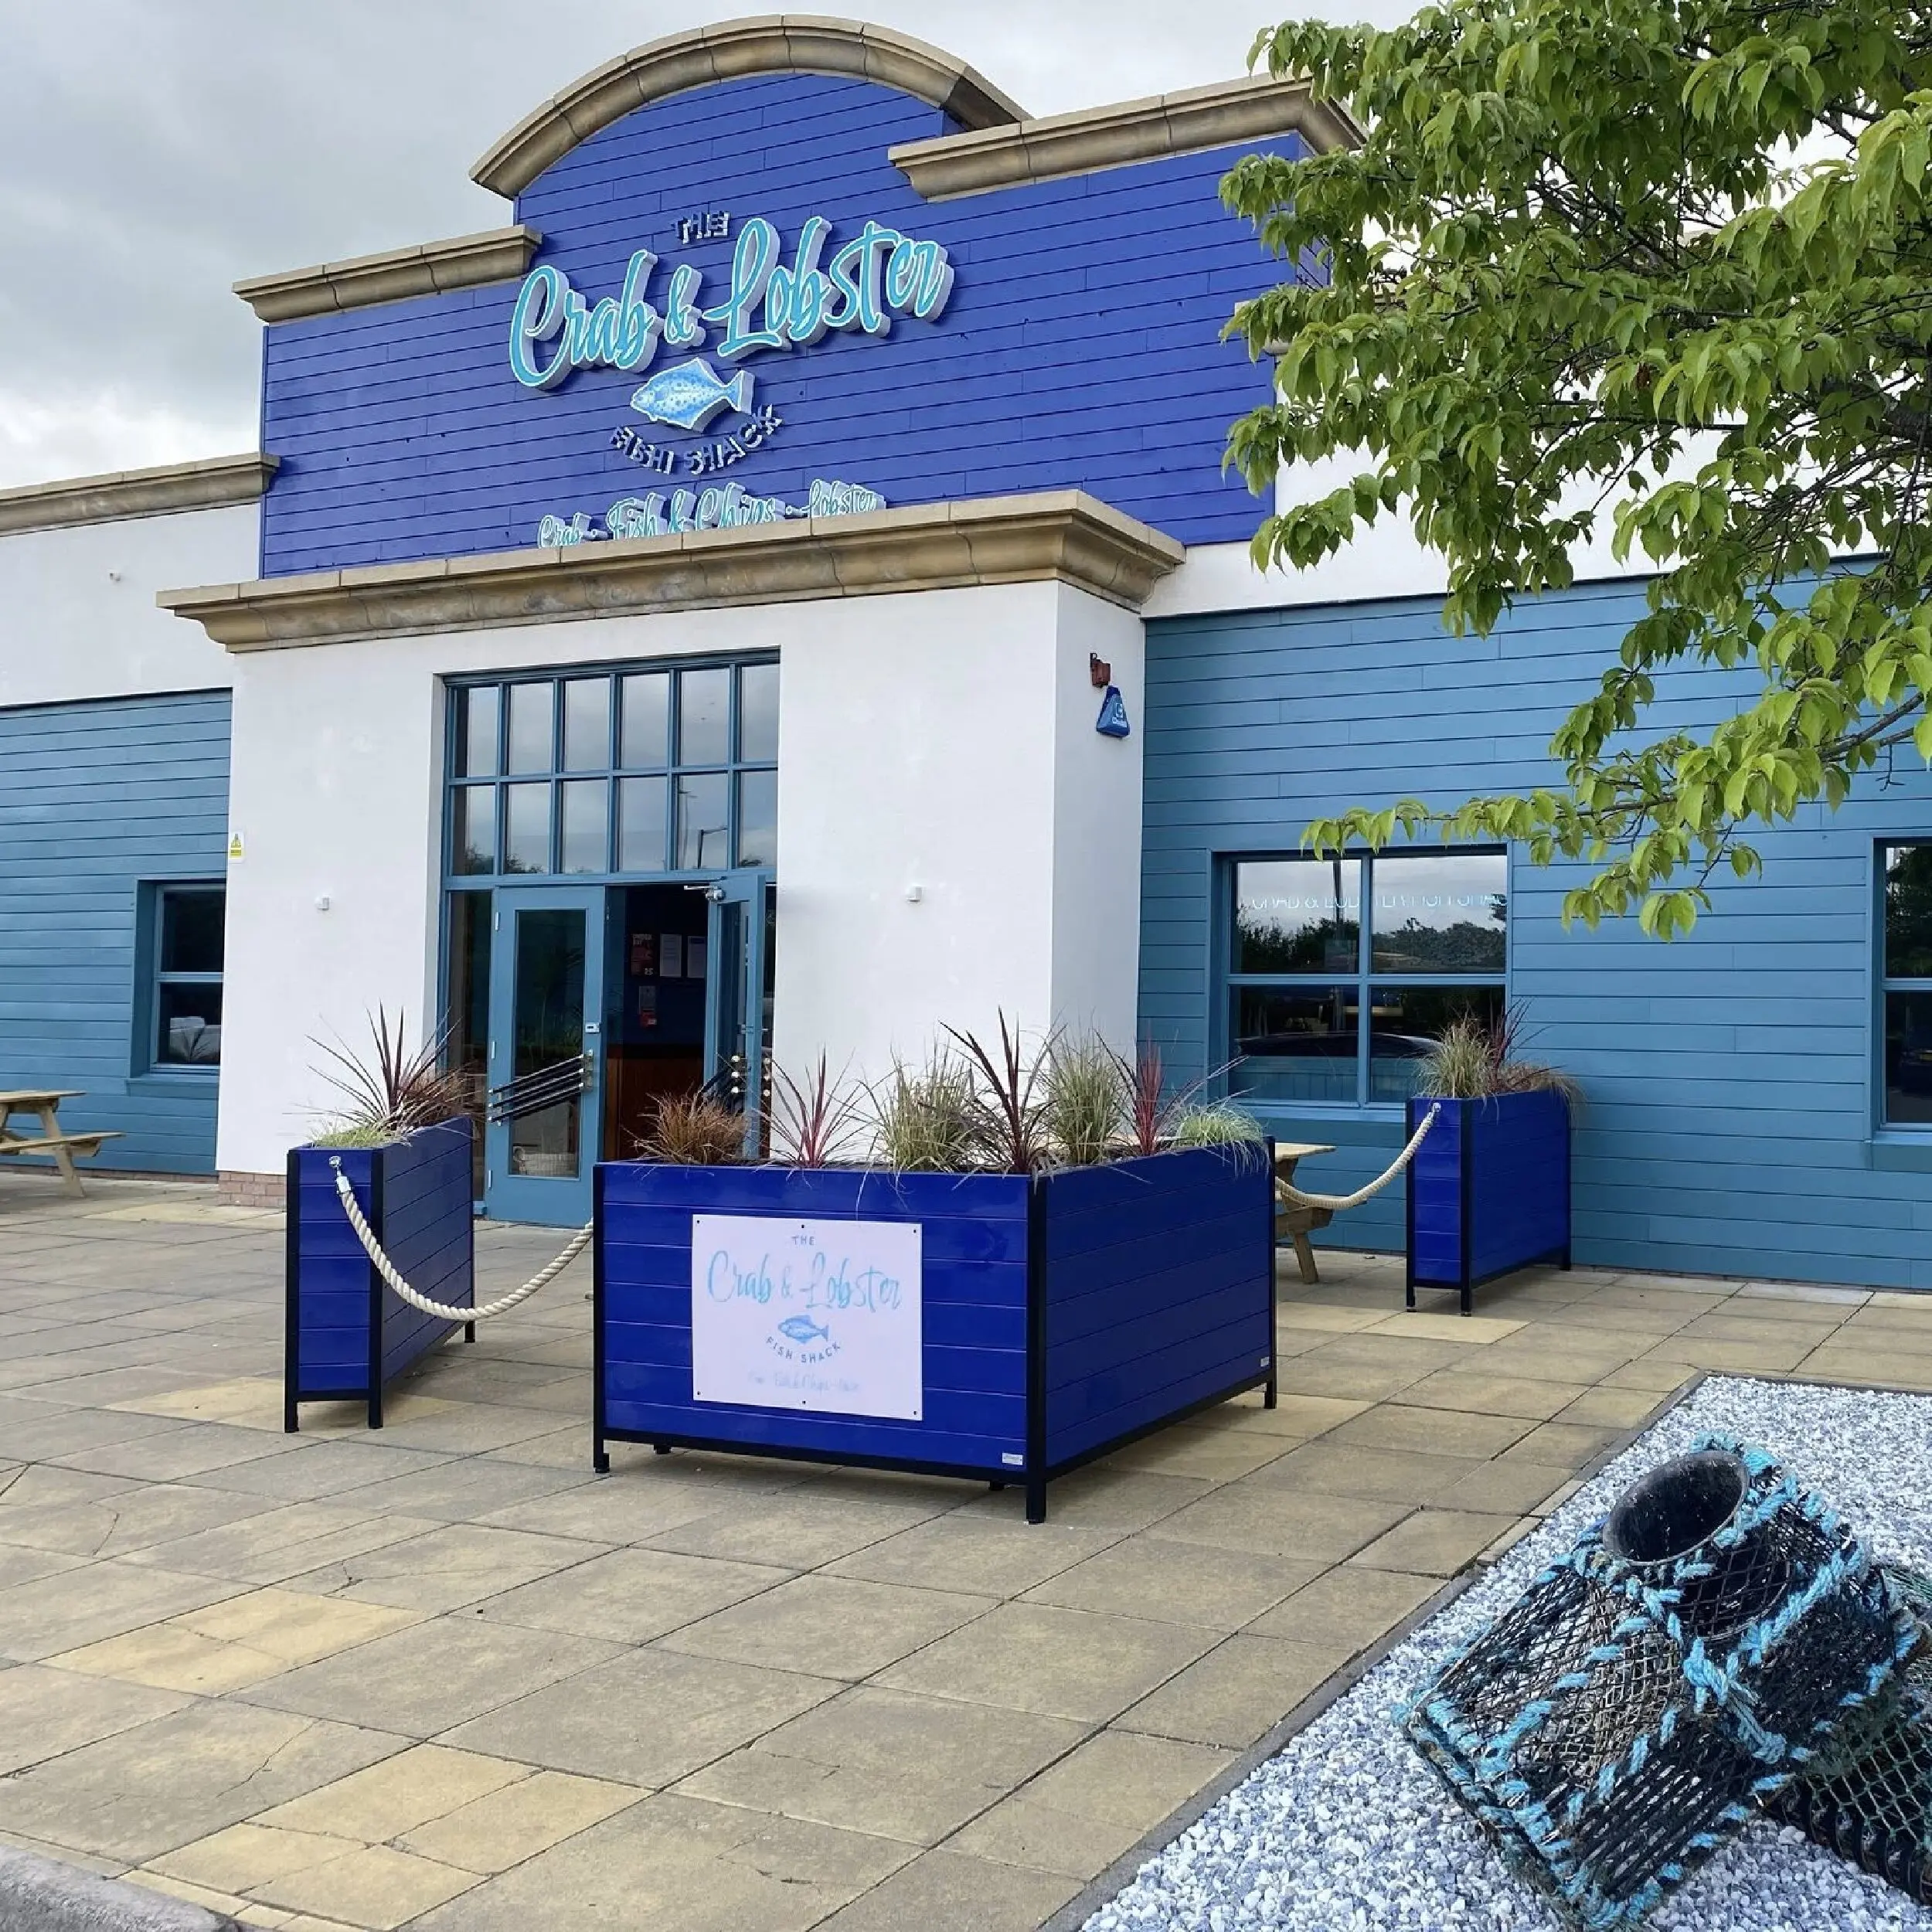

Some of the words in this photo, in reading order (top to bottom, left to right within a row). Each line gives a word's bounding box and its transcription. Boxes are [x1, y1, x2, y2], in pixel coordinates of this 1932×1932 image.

[672, 210, 730, 244] THE
[509, 249, 657, 388] Crab
[663, 264, 702, 345] &
[703, 216, 952, 358] Lobster
[609, 426, 674, 474] FISH
[684, 403, 783, 474] SHACK
[791, 1236, 815, 1246] THE
[707, 1250, 773, 1304] Crab
[781, 1265, 794, 1299] &
[799, 1252, 901, 1312] Lobster
[766, 1335, 793, 1360] FISH
[801, 1341, 841, 1364] SHACK
